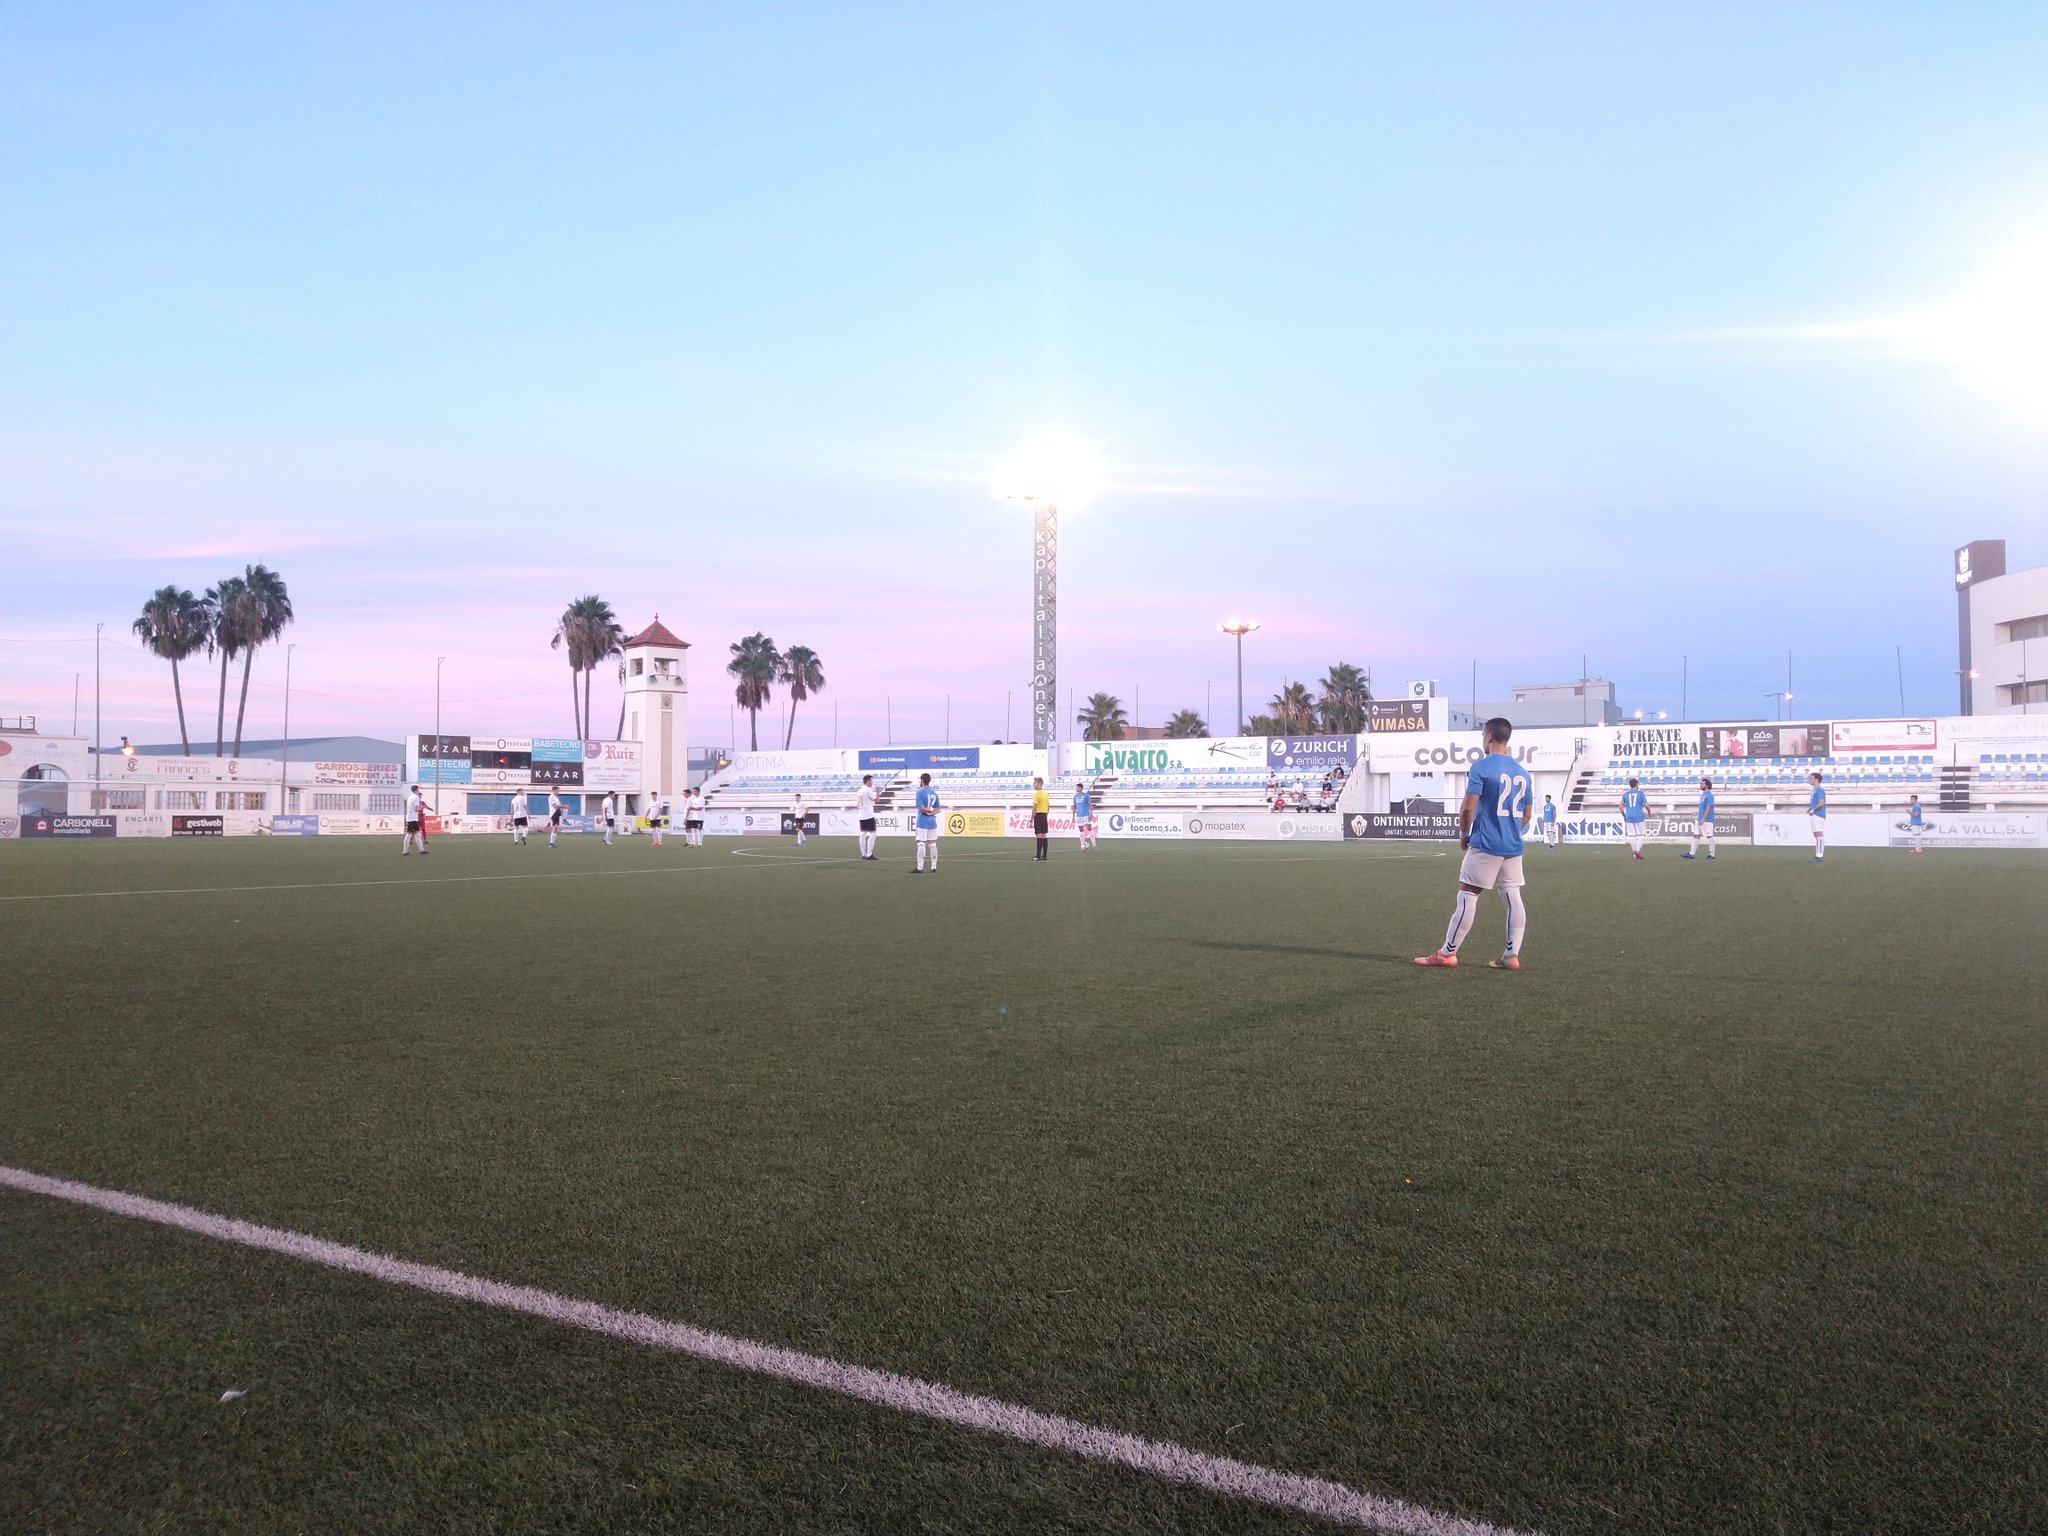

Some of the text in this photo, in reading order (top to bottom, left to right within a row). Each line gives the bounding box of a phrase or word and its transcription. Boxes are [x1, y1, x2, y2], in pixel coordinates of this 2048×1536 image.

[1371, 717, 1426, 731] VIMASA
[1629, 728, 1682, 742] FRENTE
[422, 744, 469, 754] KAZAR
[534, 740, 581, 749] BABETECNO
[1292, 740, 1348, 753] ZURICH
[1613, 742, 1699, 756] BOTIFARRA
[1414, 742, 1538, 766] cotour
[419, 759, 470, 769] BABETECNO
[1296, 755, 1325, 765] emilio
[315, 763, 398, 772] CARROSSERIES
[337, 771, 380, 779] ONTINYENT
[535, 770, 579, 779] KAZAR
[1497, 773, 1527, 818] 22
[1628, 793, 1638, 808] 17
[927, 793, 937, 809] 12
[53, 818, 113, 828] CARBONELL
[186, 819, 222, 828] gestiweb
[951, 818, 963, 830] 42
[1373, 816, 1430, 827] ONTINYENT
[1432, 816, 1452, 827] 1931
[1204, 822, 1246, 832] mopatex
[1300, 821, 1335, 833] cisne
[1714, 823, 1737, 833] cash
[1939, 825, 1959, 835] LA
